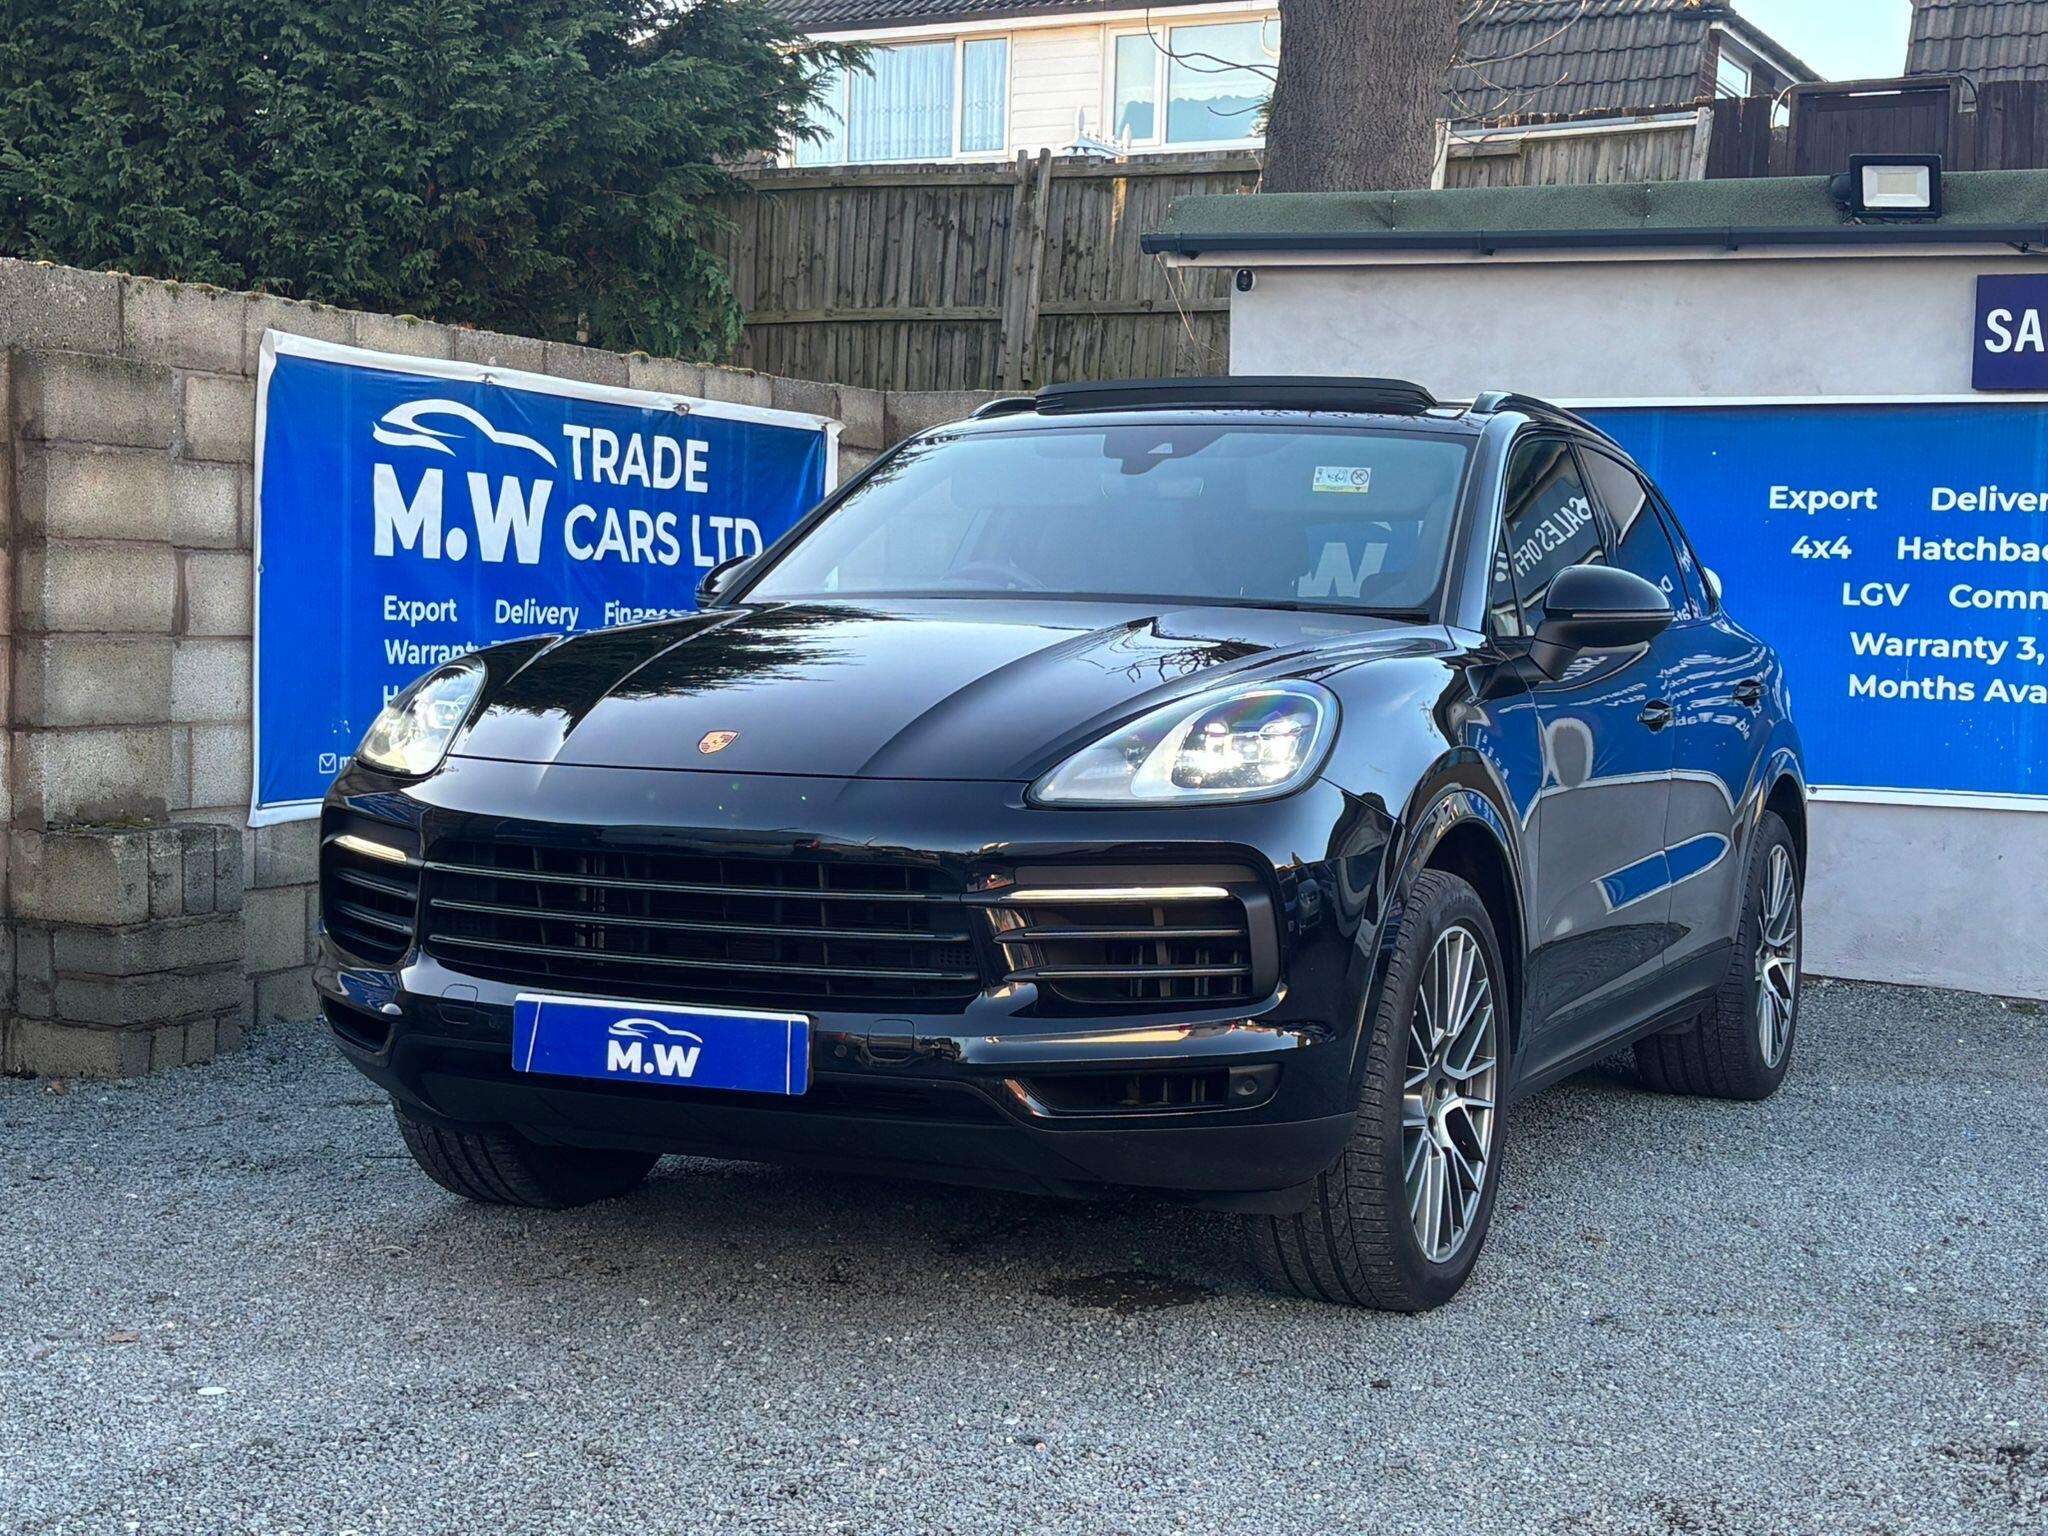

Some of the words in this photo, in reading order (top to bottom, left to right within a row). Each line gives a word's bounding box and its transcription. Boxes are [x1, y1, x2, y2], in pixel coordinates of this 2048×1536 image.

[1984, 308, 2045, 353] SA
[563, 424, 709, 493] TRADE
[373, 462, 554, 565] M.W
[1768, 485, 1878, 515] Export
[564, 503, 681, 567] CARS
[692, 514, 764, 567] LTD
[1790, 535, 1852, 560] 4x4
[1842, 582, 1910, 607] LGV
[383, 594, 458, 627] Export
[495, 598, 580, 632] Delivery
[604, 600, 683, 625] Finan
[384, 638, 480, 665] Warran
[1850, 631, 2009, 665] Warranty
[2016, 636, 2045, 666] 3,
[1848, 673, 1976, 701] Months
[607, 1039, 701, 1078] M.W
